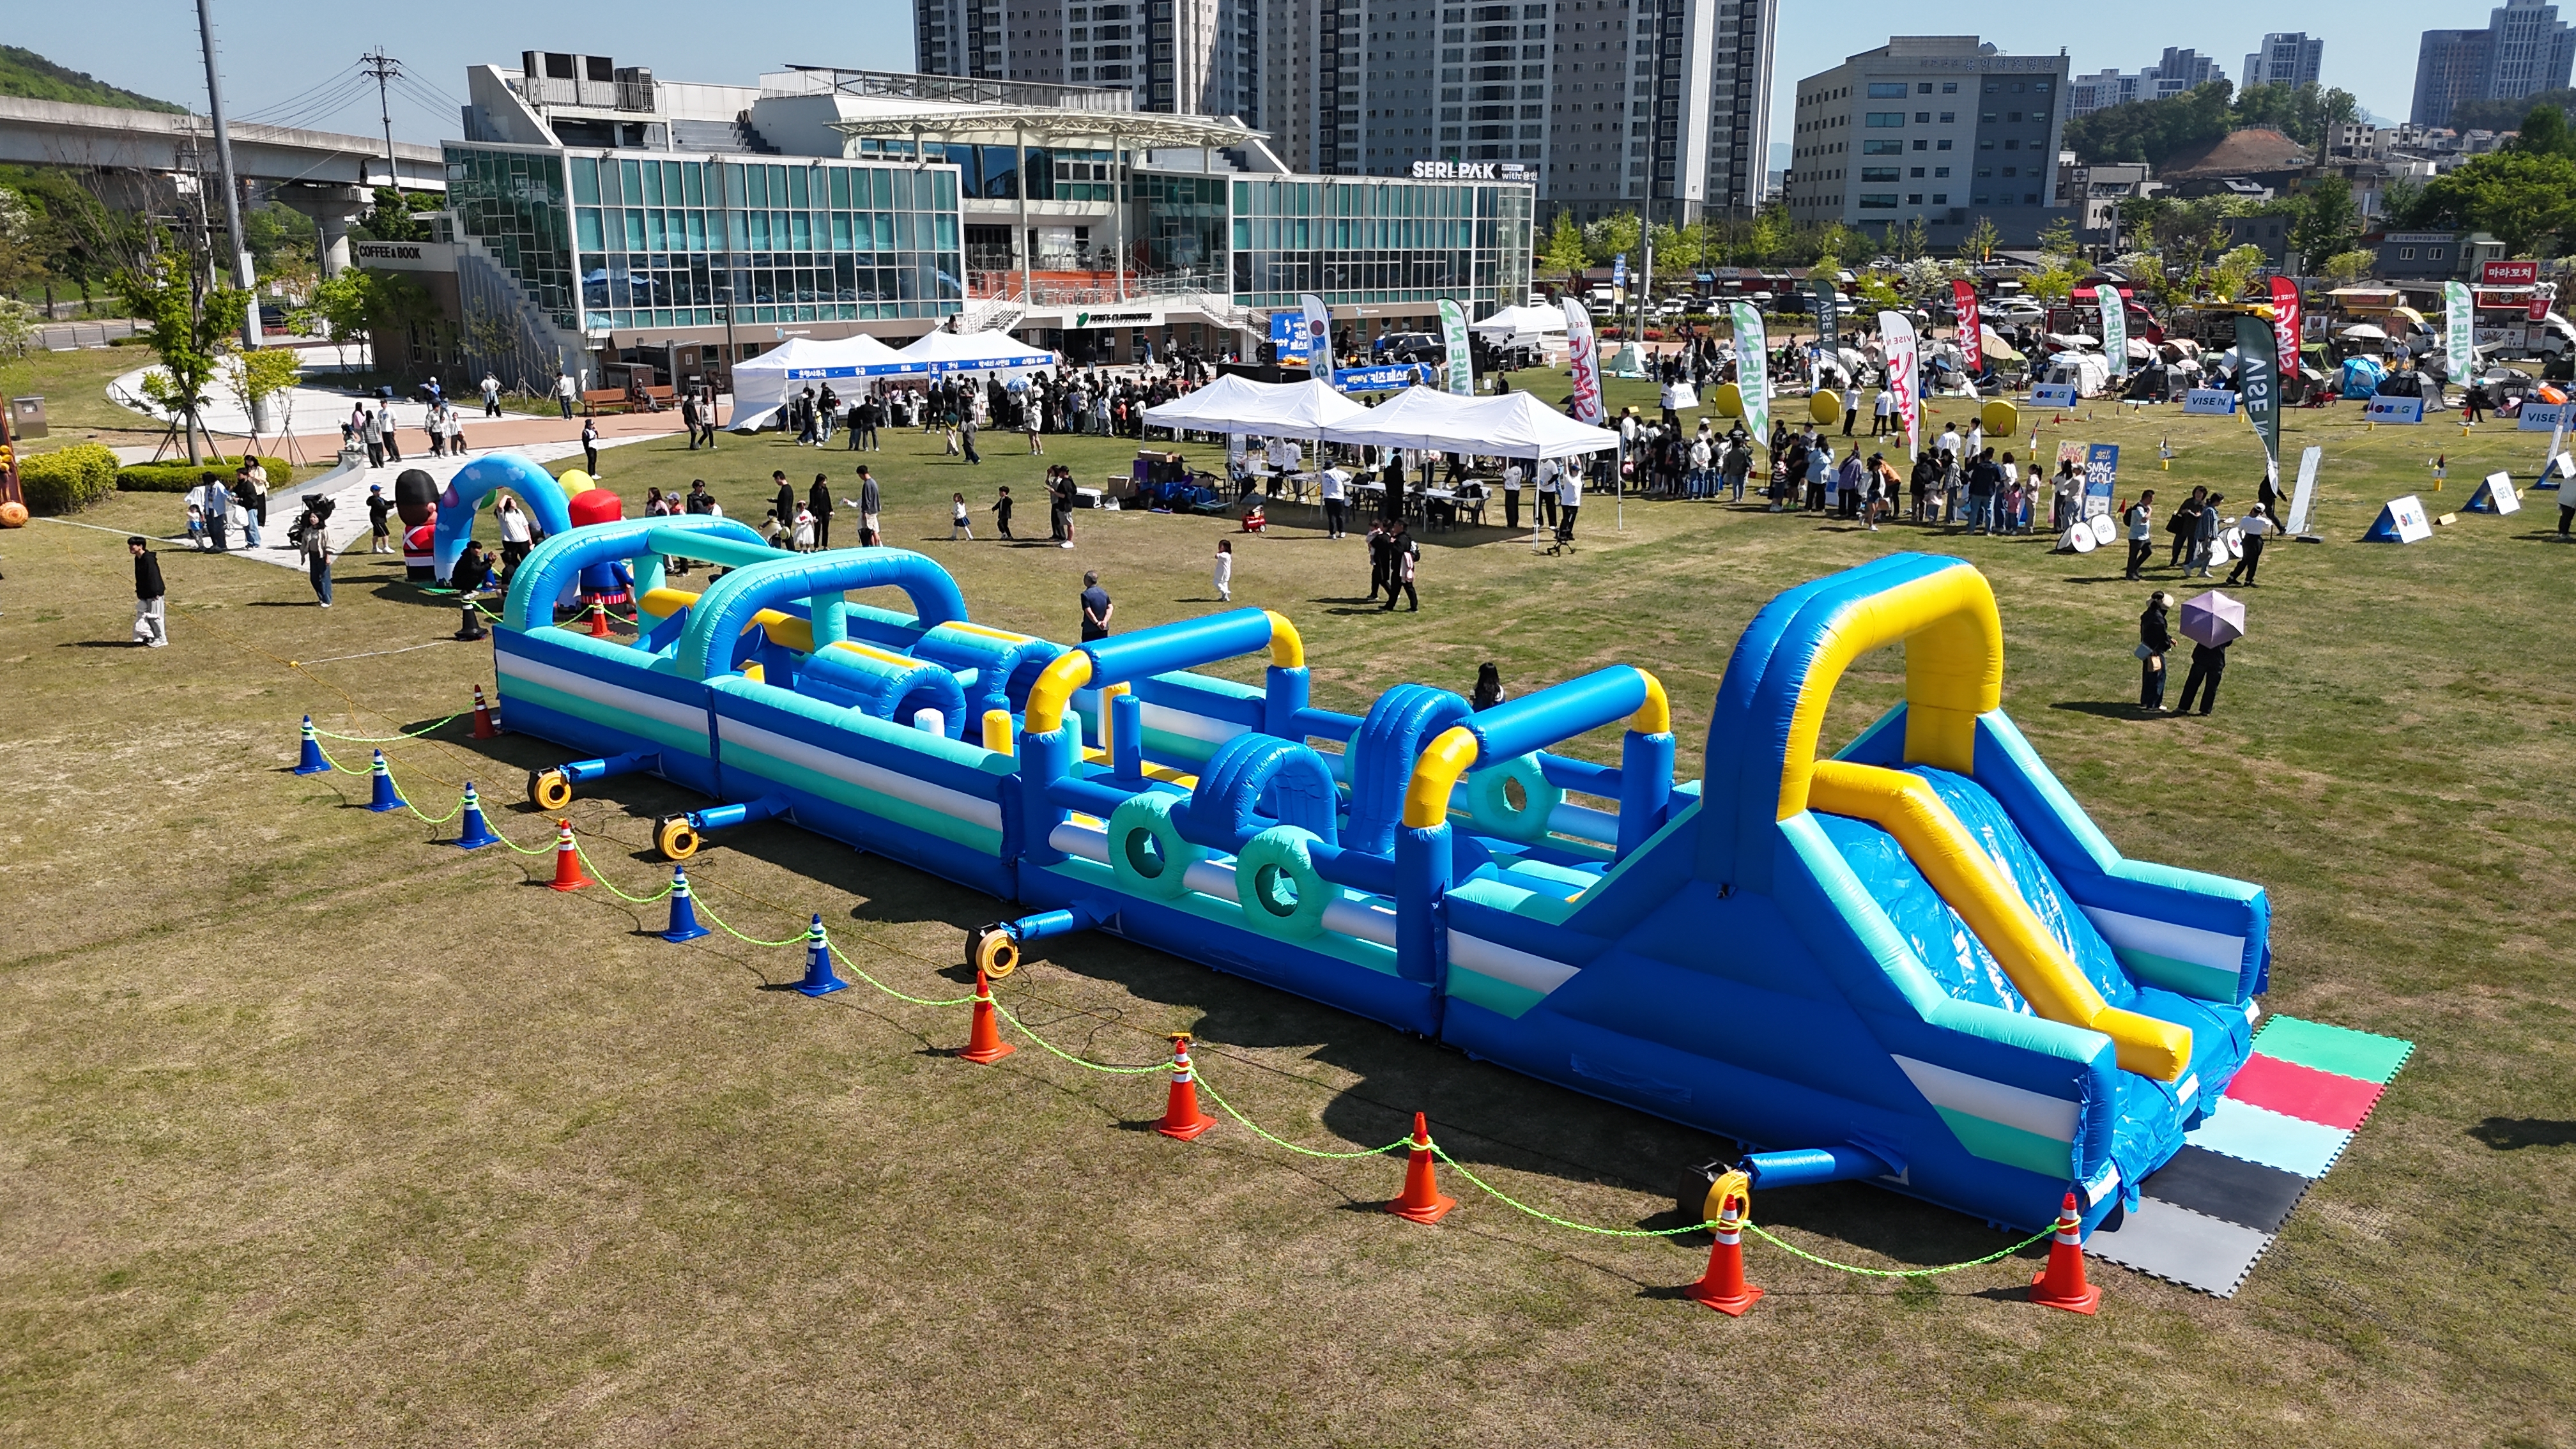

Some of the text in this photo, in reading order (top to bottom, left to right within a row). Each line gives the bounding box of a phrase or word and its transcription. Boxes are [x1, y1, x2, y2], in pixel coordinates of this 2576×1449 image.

[1966, 58, 2053, 72] 용인서울병원
[1413, 161, 1496, 179] SERI PAK
[1501, 170, 1538, 181] with 용인
[359, 245, 421, 259] COFFEE & BOOK
[2488, 266, 2531, 279] 마라꼬치
[799, 369, 827, 378] 운영사무국
[2527, 413, 2556, 422] VISE
[2086, 461, 2112, 473] SNAG
[2089, 472, 2116, 484] GOLF
